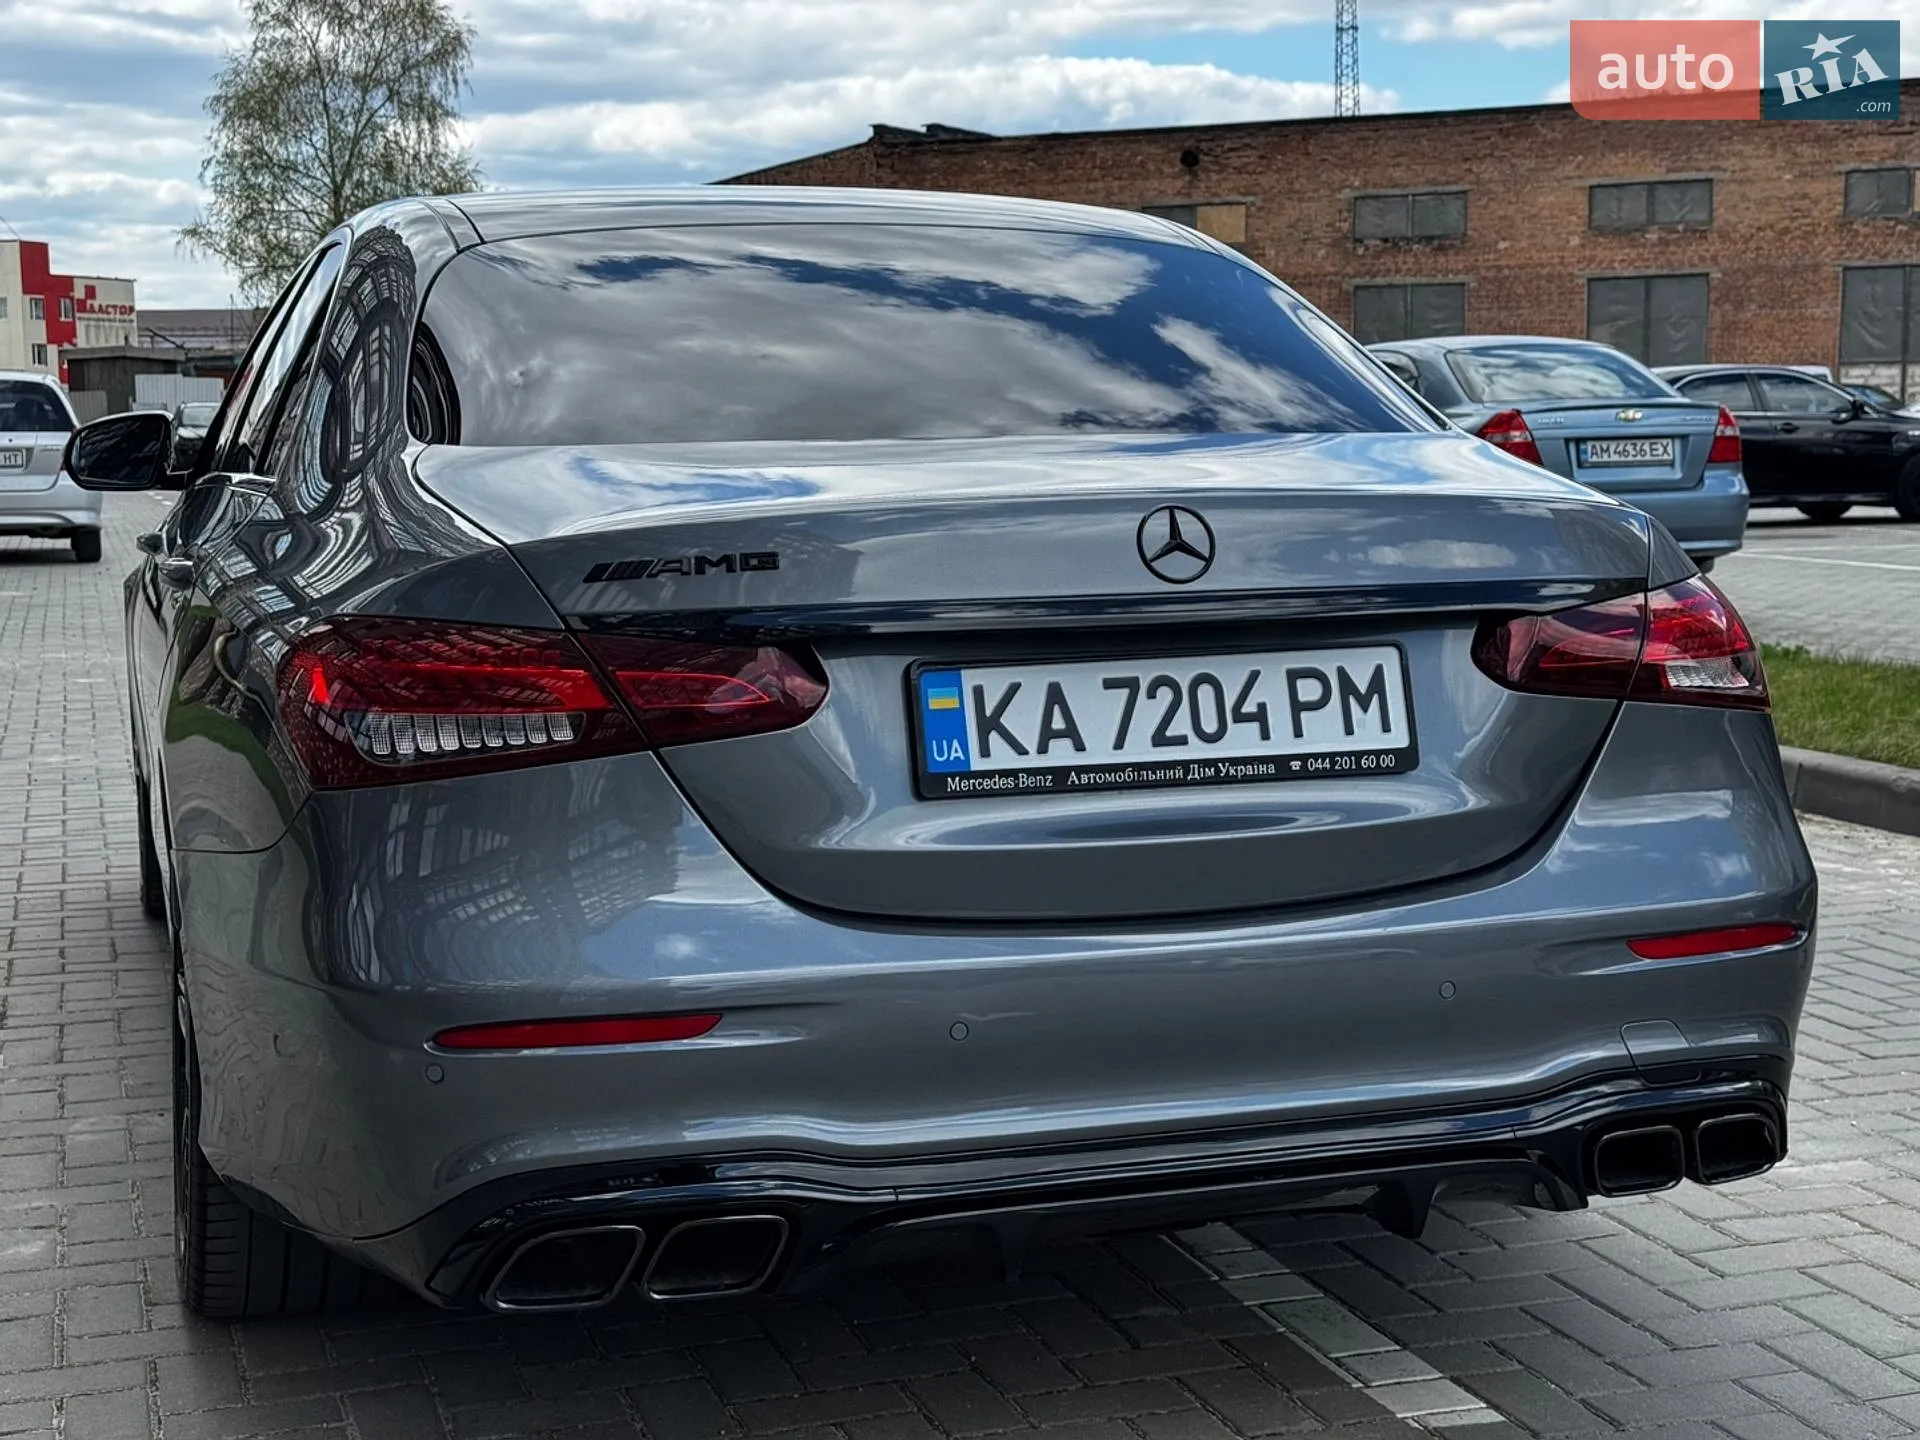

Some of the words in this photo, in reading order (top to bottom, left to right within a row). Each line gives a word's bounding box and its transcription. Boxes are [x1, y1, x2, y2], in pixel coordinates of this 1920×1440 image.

[1590, 443, 1611, 458] AM
[1613, 442, 1647, 458] 4636
[1649, 441, 1671, 456] EX
[646, 551, 779, 578] AMG
[972, 681, 1087, 758] KA
[1102, 668, 1271, 750] 7204
[1286, 663, 1393, 738] PM
[933, 740, 965, 762] UA
[947, 772, 1053, 791] Mercedes-Benz
[1067, 765, 1183, 786] Автомобільний
[1188, 764, 1215, 780] Дім
[1218, 761, 1276, 778] Україна
[1308, 757, 1330, 771] 044
[1335, 756, 1356, 770] 201
[1361, 755, 1376, 768] 60
[1380, 754, 1395, 767] 00
